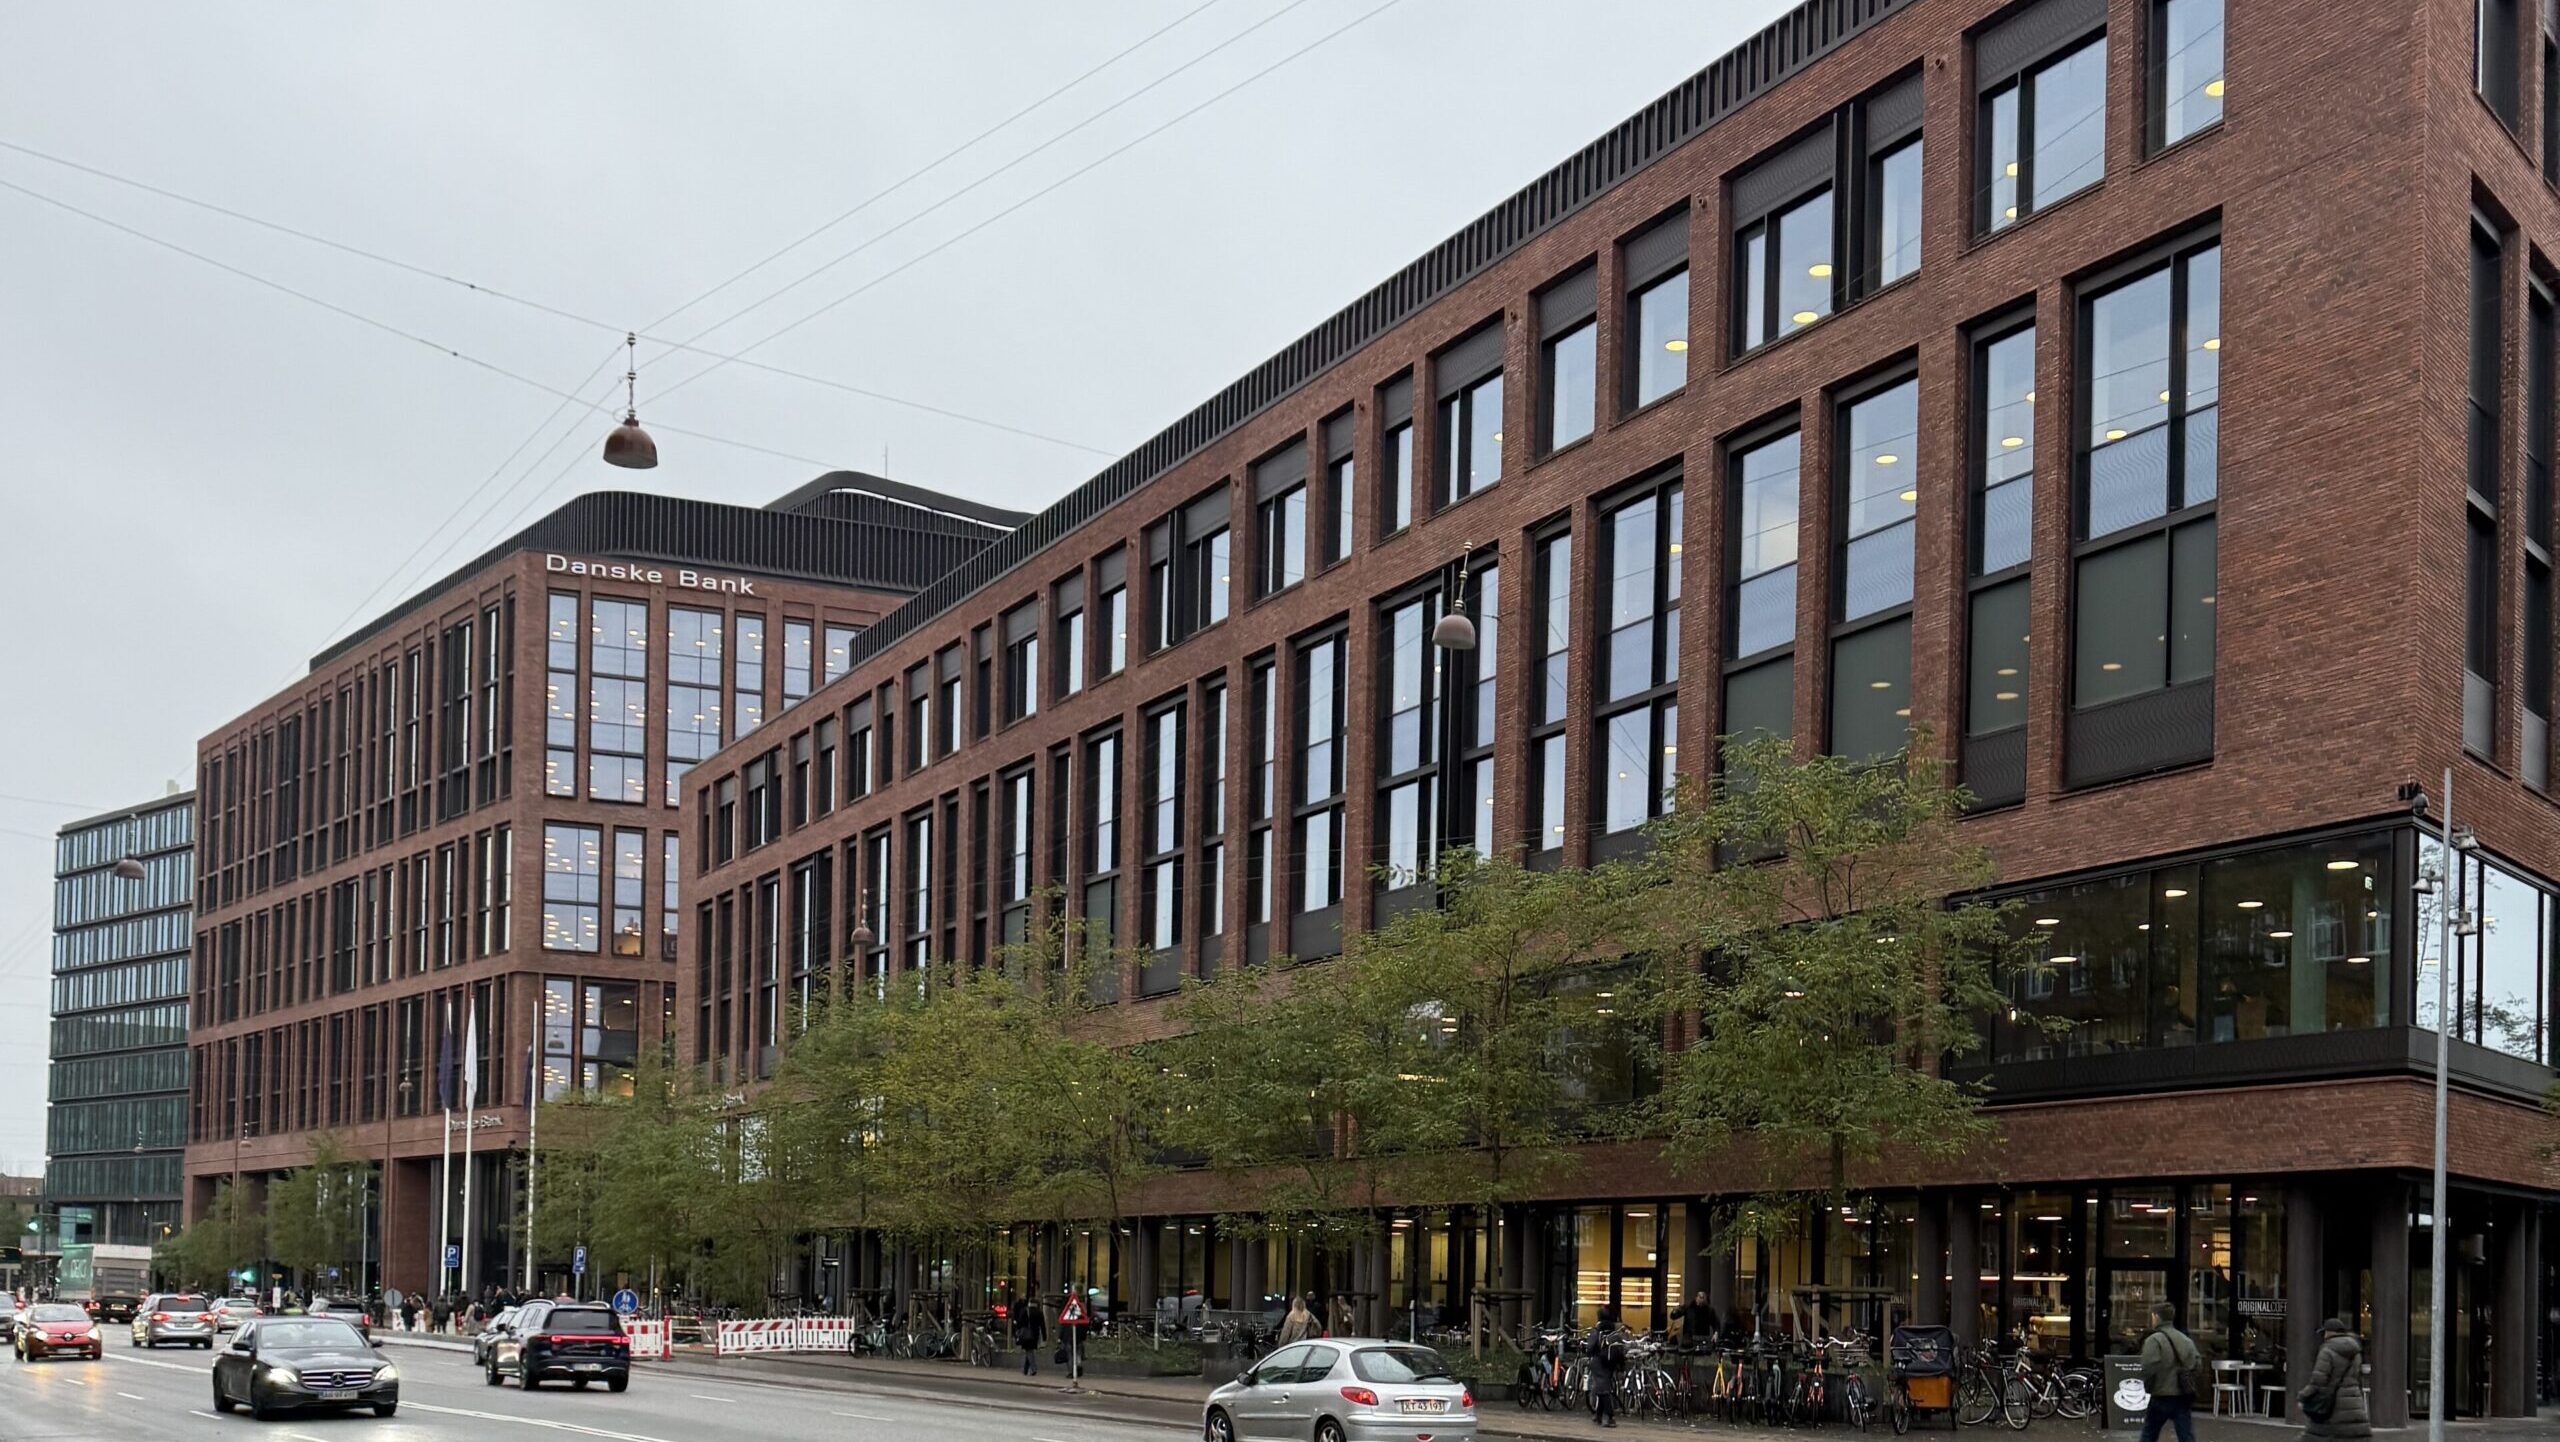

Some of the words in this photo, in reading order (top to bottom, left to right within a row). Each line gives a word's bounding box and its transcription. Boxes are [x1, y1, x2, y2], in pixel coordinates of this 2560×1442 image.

[546, 554, 663, 584] Danske
[679, 570, 754, 595] Bank
[447, 1247, 456, 1258] P
[576, 1249, 583, 1261] P
